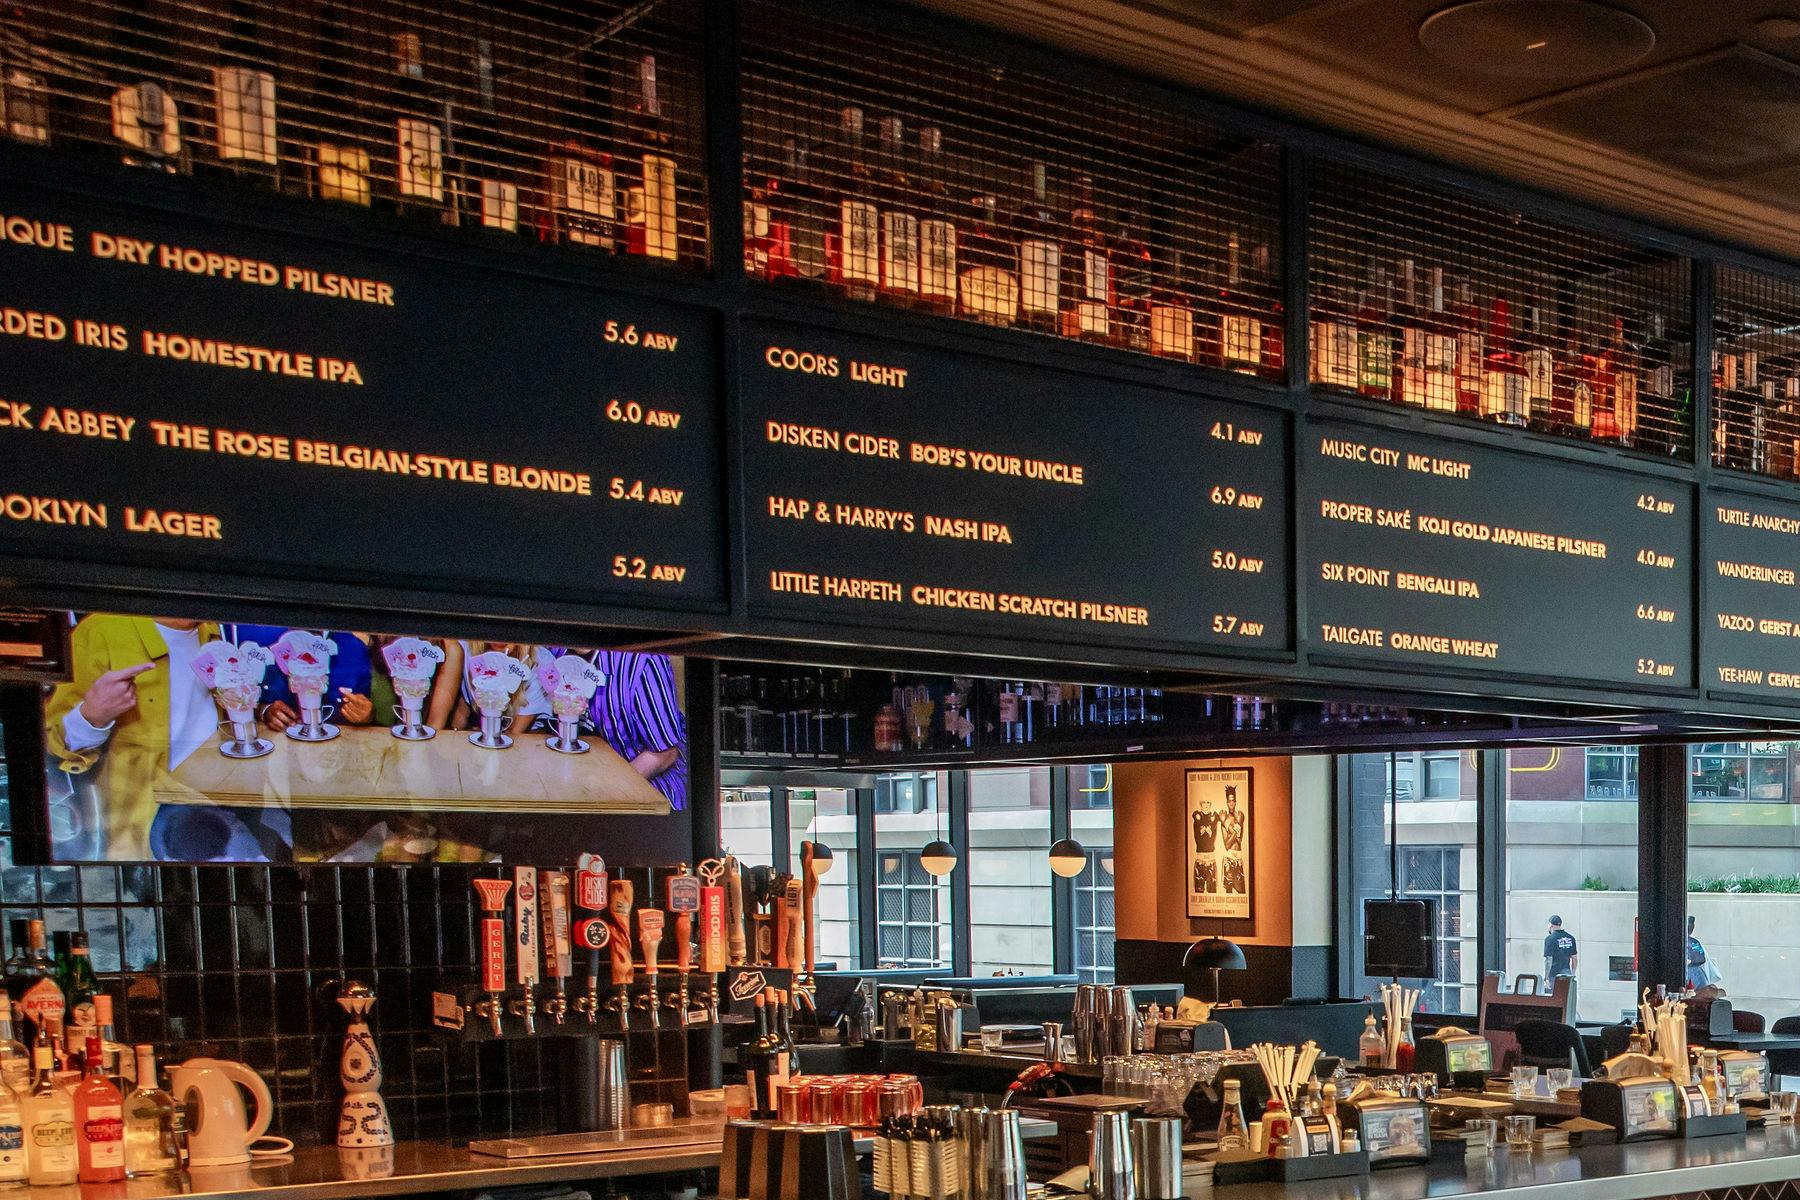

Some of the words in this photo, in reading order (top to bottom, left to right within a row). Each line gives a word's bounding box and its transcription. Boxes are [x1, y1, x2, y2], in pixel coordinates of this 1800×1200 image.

[92, 233, 153, 263] DRY
[160, 245, 279, 285] HOPPED
[285, 267, 394, 305] PILSNER
[0, 309, 66, 340] DED
[75, 320, 128, 350] IRIS
[143, 331, 313, 377] HOMESTYLE
[319, 358, 363, 384] IPA
[604, 321, 638, 345] 5.6
[643, 333, 677, 351] ABV
[766, 347, 839, 376] COORS
[851, 362, 907, 387] LIGHT
[607, 400, 641, 423] 6.0
[646, 411, 680, 428] ABV
[1211, 422, 1232, 441] 4.1
[1238, 431, 1262, 445] ABV
[40, 407, 135, 441] ABBEY
[150, 421, 210, 450] THE
[215, 430, 290, 460] ROSE
[295, 439, 488, 483] BELGIAN-STYLE
[493, 464, 591, 495] BLONDE
[767, 421, 839, 451] DISKEN
[844, 433, 900, 459] CIDER
[910, 443, 966, 467] BOB'S
[969, 451, 1021, 476] YOUR
[1025, 459, 1083, 485] UNCLE
[1322, 439, 1366, 461] MUSIC
[1370, 448, 1399, 467] CITY
[1408, 454, 1429, 472] MC
[1433, 459, 1470, 479] LIGHT
[610, 478, 644, 501] 5.4
[648, 488, 683, 505] ABV
[1211, 486, 1235, 505] 6.9
[1238, 494, 1262, 509] ABV
[1637, 495, 1654, 510] 4.2
[1657, 502, 1674, 514] ABV
[0, 494, 107, 528] OKLYN
[125, 508, 222, 539] LAGER
[768, 496, 809, 519] HAP
[815, 502, 830, 522] &
[836, 505, 914, 532] HARRY'S
[925, 516, 978, 539] NASH
[982, 523, 1012, 543] IPA
[1322, 500, 1372, 524] PROPER
[1377, 509, 1410, 529] SAKÉ
[1418, 516, 1449, 535] KOJI
[1452, 521, 1490, 540] GOLD
[1491, 528, 1555, 550] JAPANESE
[1557, 537, 1606, 558] PILSNER
[1717, 508, 1749, 526] TURTLE
[1752, 515, 1800, 534] ANARCHY
[613, 556, 646, 578] 5.2
[651, 565, 685, 582] ABV
[1212, 550, 1236, 570] 5.0
[1238, 558, 1263, 573] ABV
[1637, 550, 1655, 565] 4.0
[1657, 556, 1674, 568] ABV
[1322, 563, 1343, 581] SIX
[1347, 566, 1389, 586] POINT
[1397, 573, 1455, 595] BENGALI
[1458, 581, 1479, 598] IPA
[1717, 561, 1794, 585] WANDERLINGER
[771, 571, 819, 594] LITTLE
[824, 576, 901, 602] HARPETH
[912, 586, 995, 611] CHICKEN
[998, 594, 1076, 618] SCRATCH
[1080, 602, 1148, 625] PILSNER
[1213, 615, 1237, 633] 5.7
[1239, 622, 1264, 636] ABV
[1637, 604, 1655, 619] 6.6
[1656, 610, 1674, 622] ABV
[1718, 614, 1754, 631] YAZOO
[1759, 619, 1792, 636] GERST
[1322, 625, 1382, 646] TAILGATE
[1391, 633, 1449, 653] ORANGE
[1452, 639, 1498, 658] WHEAT
[1637, 659, 1654, 674] 5.2
[1657, 665, 1674, 676] ABV
[1719, 667, 1763, 684] YEE-HAW
[711, 894, 721, 914] IRIS
[787, 883, 798, 908] LIGHT
[711, 916, 721, 965] BEARDED
[492, 929, 502, 981] GERST
